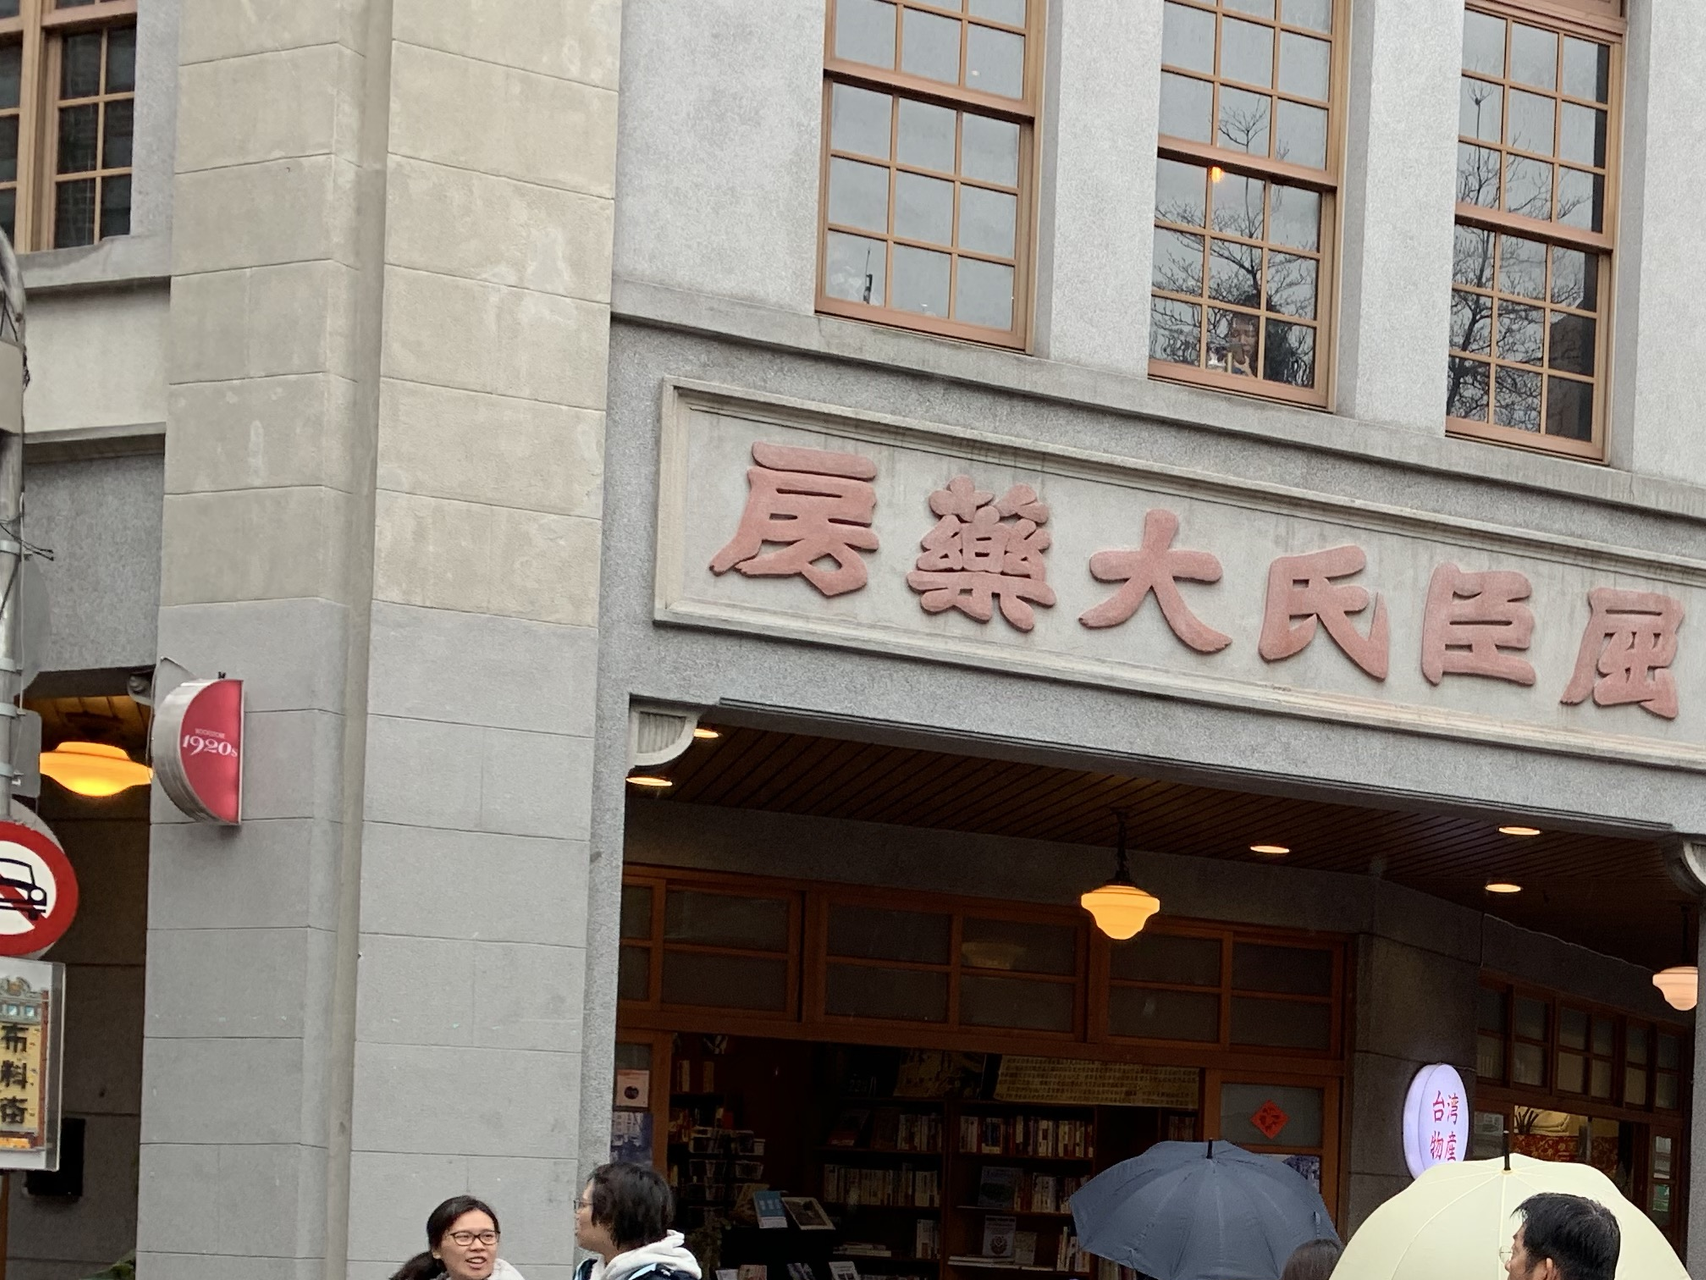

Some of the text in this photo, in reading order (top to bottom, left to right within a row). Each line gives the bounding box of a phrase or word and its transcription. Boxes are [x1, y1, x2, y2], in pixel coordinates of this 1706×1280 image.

[710, 440, 1686, 720] 屈臣氏大藥房
[182, 734, 239, 757] 1920s
[1432, 1089, 1460, 1126] 台湾
